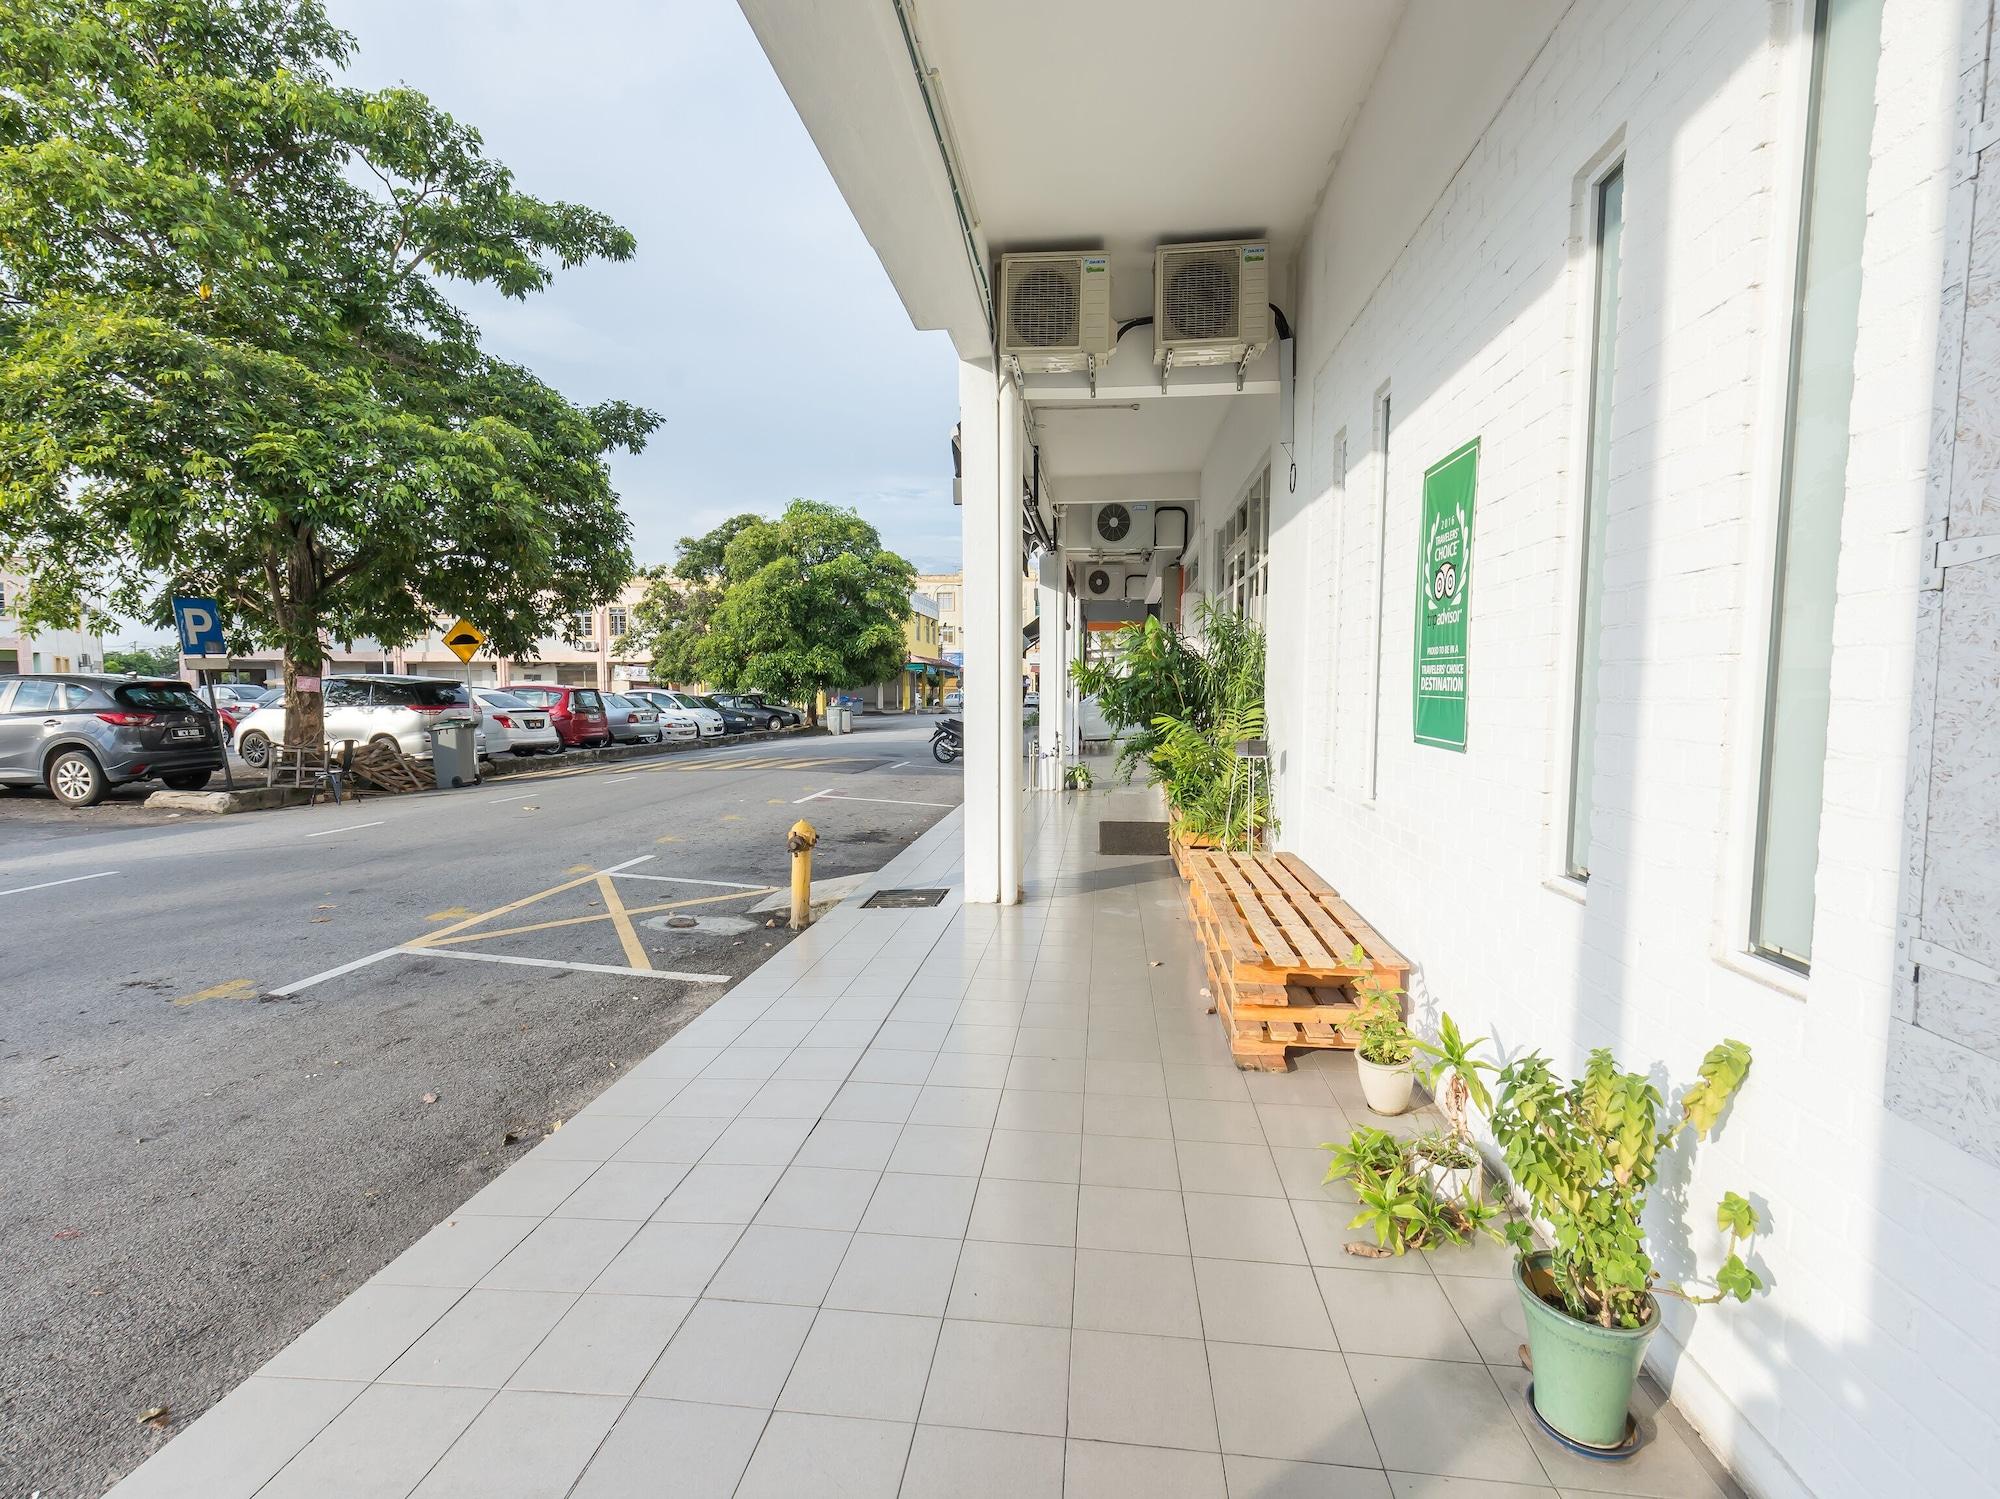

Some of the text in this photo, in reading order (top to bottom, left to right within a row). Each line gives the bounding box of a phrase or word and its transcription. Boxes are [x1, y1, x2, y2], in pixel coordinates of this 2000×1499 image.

[1441, 515, 1455, 530] 2016
[1434, 540, 1460, 562] CHOICE
[183, 608, 212, 644] P
[1427, 607, 1462, 630] tripadvisor
[1446, 663, 1464, 675] CHOICE
[1421, 676, 1464, 692] DESTINATION
